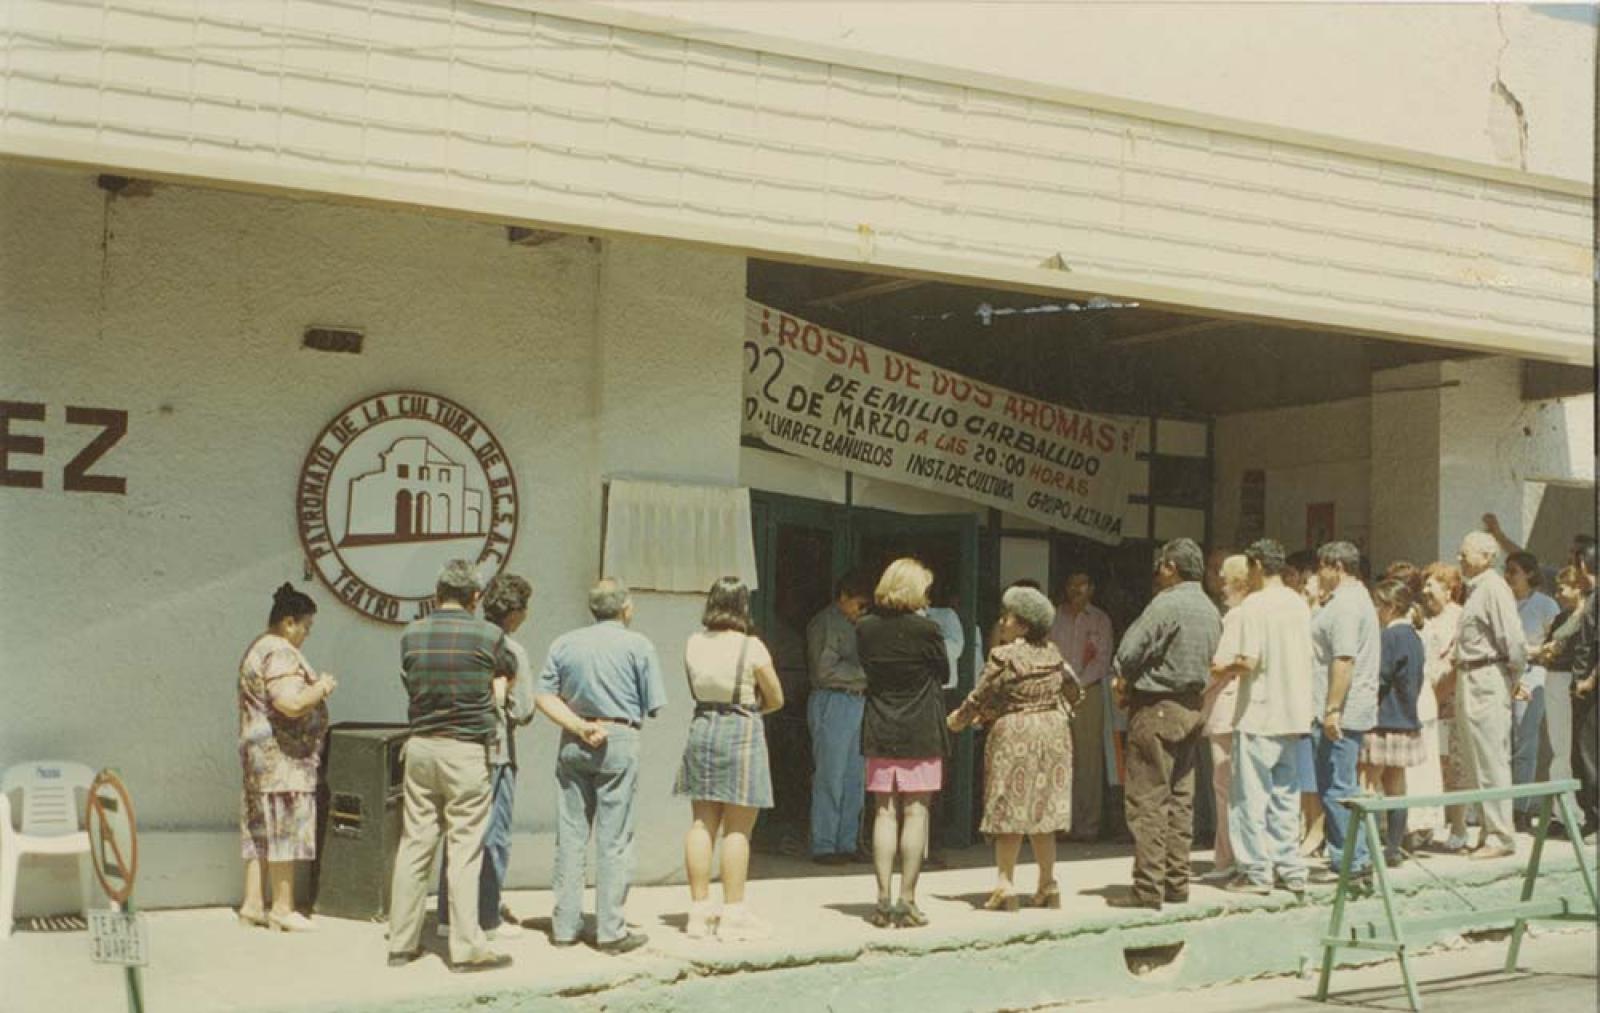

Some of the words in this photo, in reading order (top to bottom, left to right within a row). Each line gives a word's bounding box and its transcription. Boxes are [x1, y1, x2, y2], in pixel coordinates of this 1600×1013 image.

[884, 355, 920, 389] DE
[932, 371, 993, 409] DOS
[331, 413, 359, 444] DE
[362, 399, 389, 422] LA
[398, 395, 479, 442] CULTURA
[475, 441, 502, 469] DE
[787, 385, 824, 418] DE
[832, 401, 910, 443] MARZO
[914, 428, 928, 445] A
[935, 434, 969, 455] LAS
[974, 443, 1026, 477] 20:00
[1029, 463, 1089, 497] HORAS
[825, 372, 861, 401] DE
[863, 386, 958, 428] EMILIO
[964, 416, 1100, 477] CARBALLIDO
[1027, 491, 1072, 519] GRUPO
[333, 567, 400, 620] TEATRO
